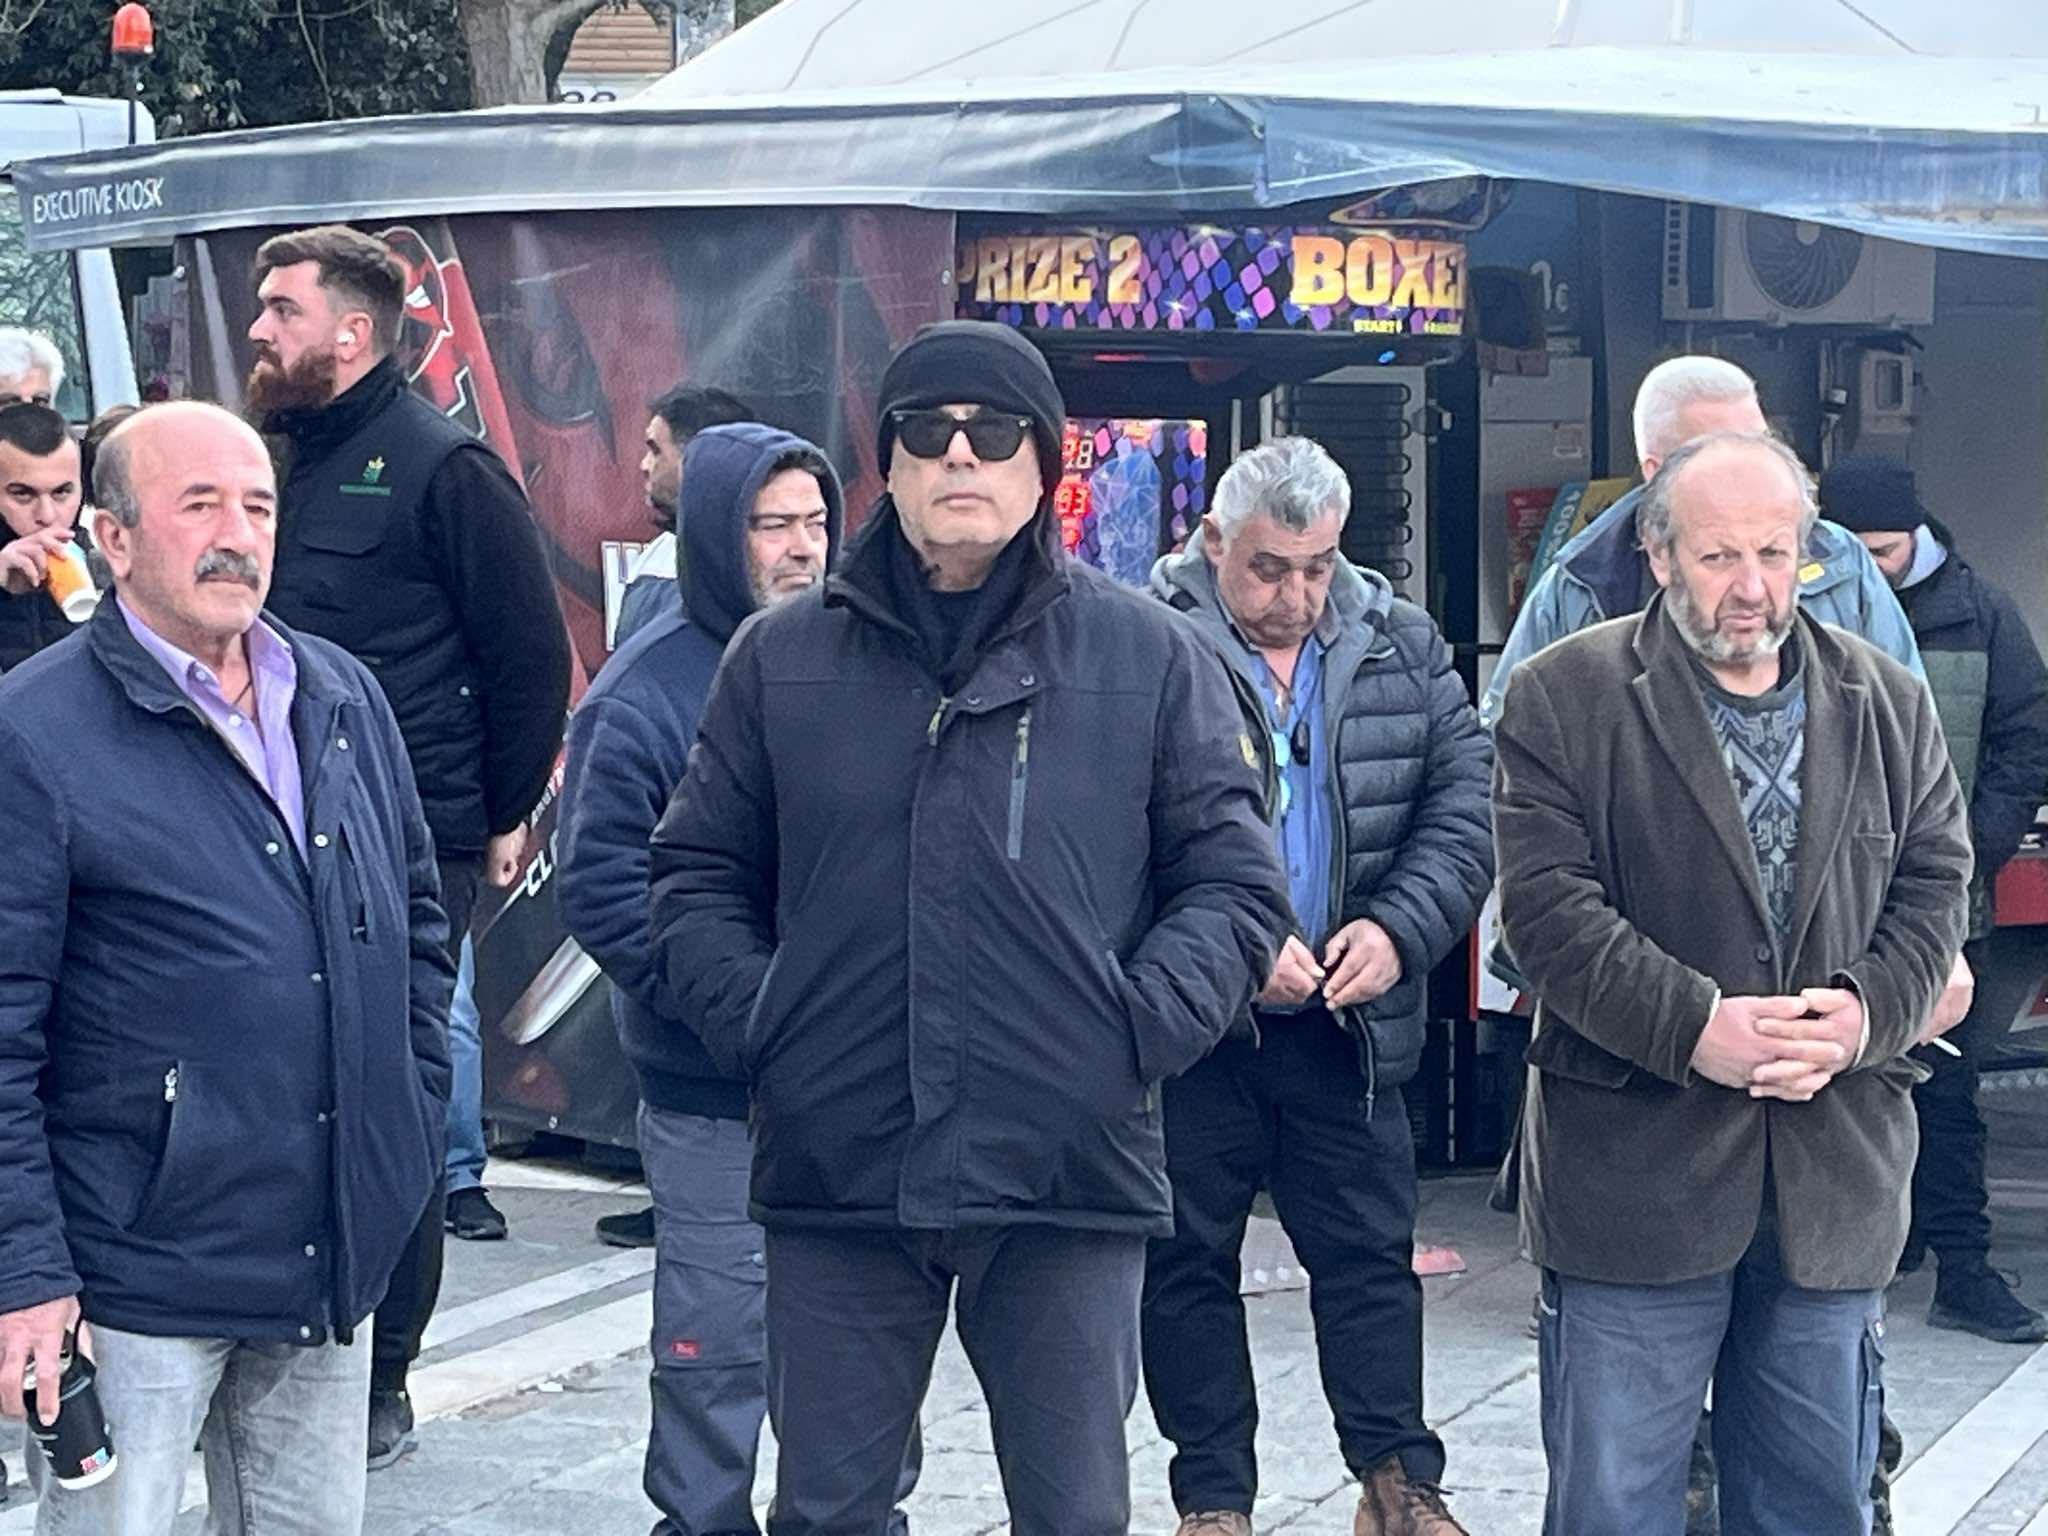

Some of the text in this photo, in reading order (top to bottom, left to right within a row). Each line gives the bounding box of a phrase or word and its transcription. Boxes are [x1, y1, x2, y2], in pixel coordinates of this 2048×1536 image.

[33, 177, 165, 223] EXECUTIVE KIOSK
[1107, 234, 1144, 303] 2
